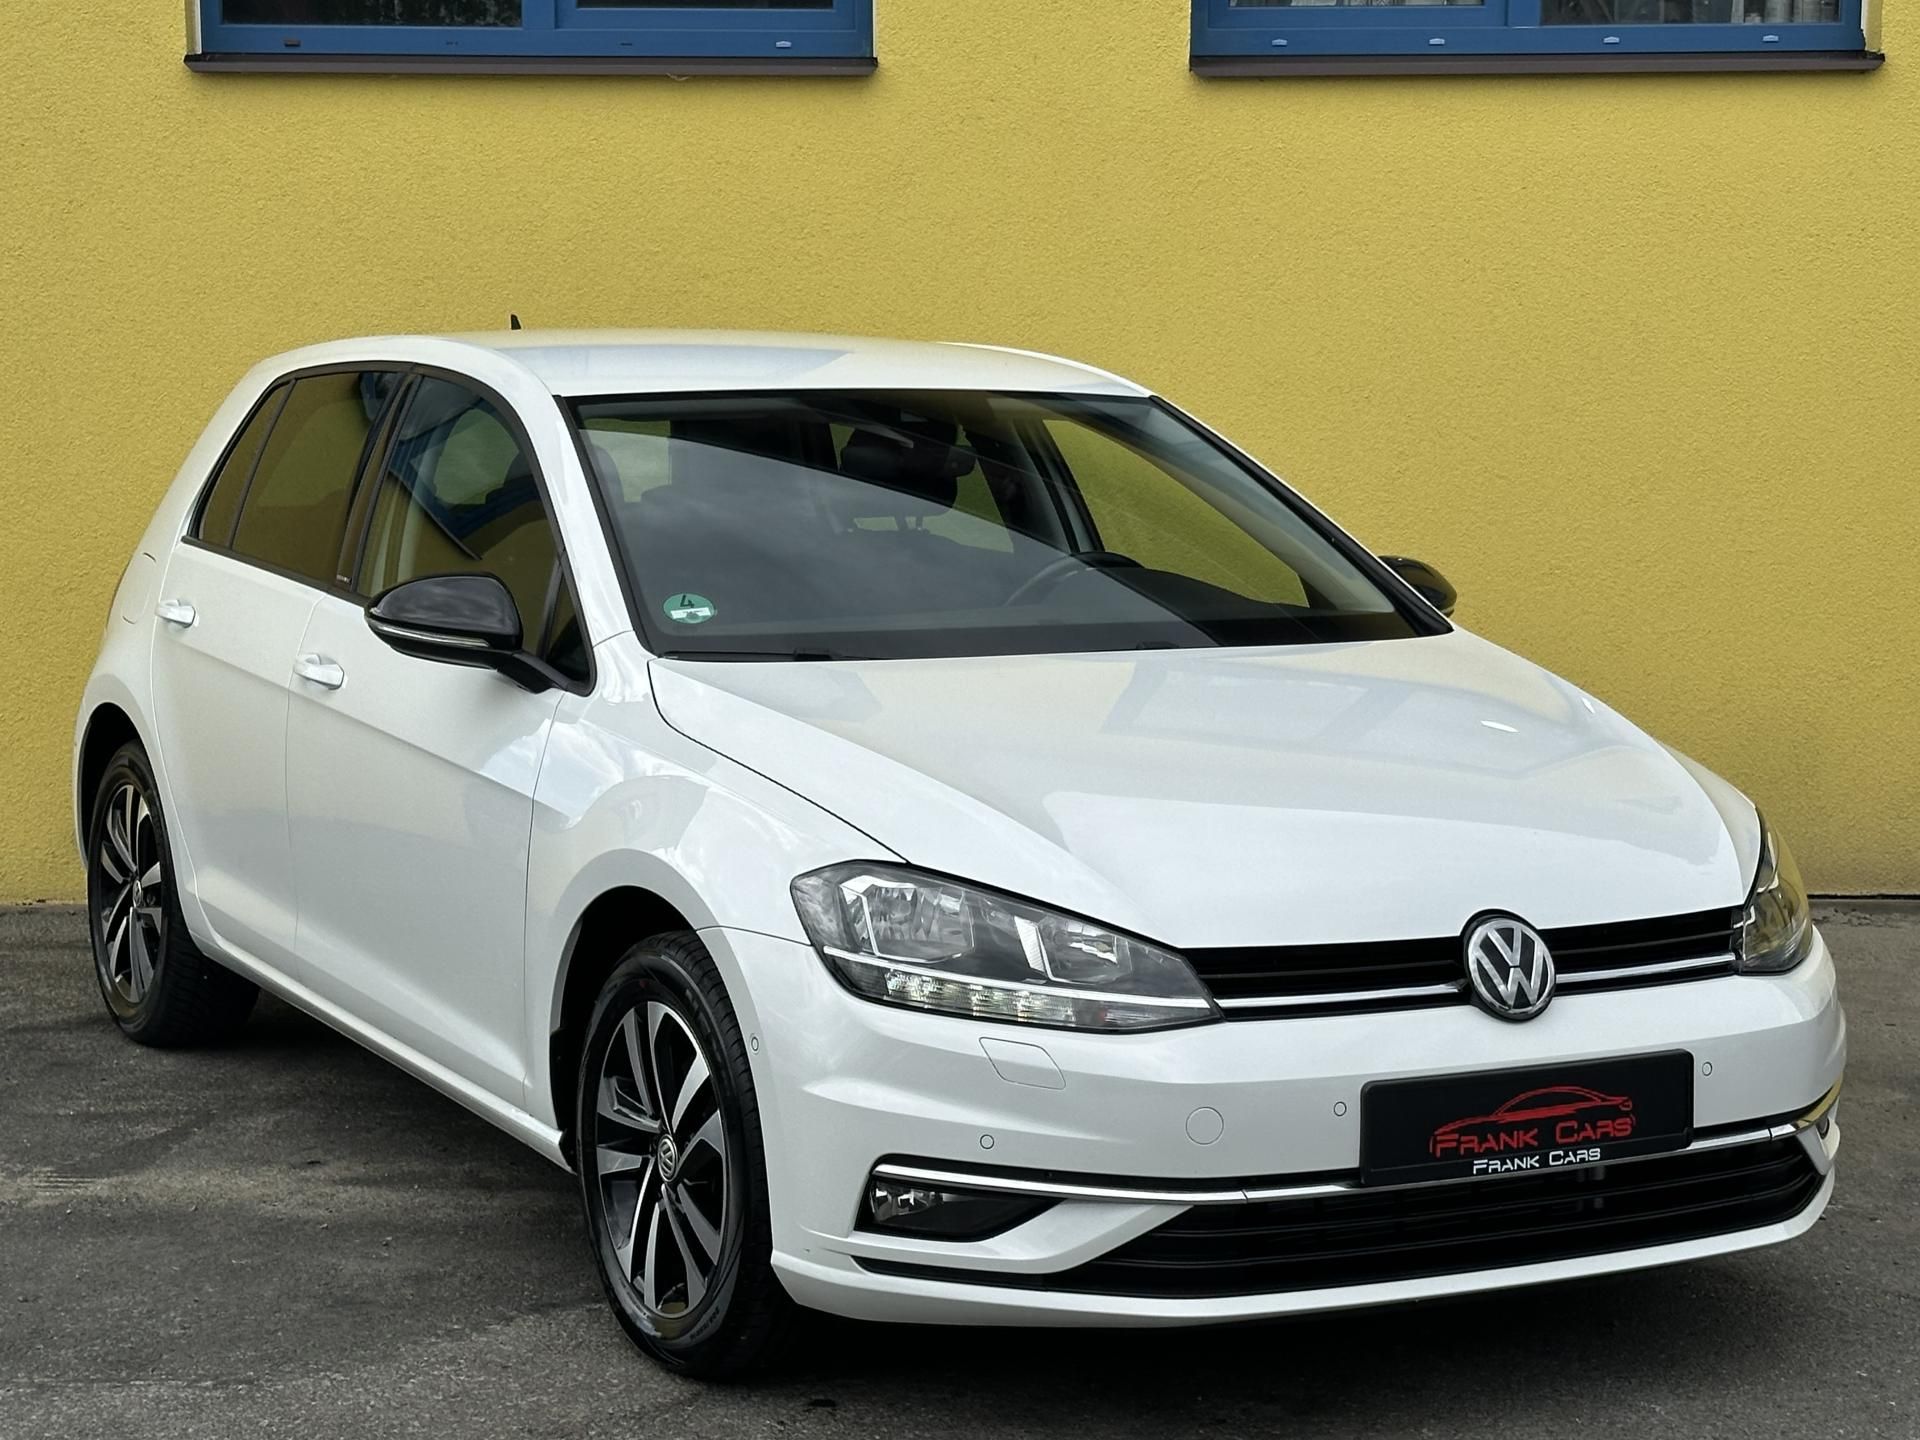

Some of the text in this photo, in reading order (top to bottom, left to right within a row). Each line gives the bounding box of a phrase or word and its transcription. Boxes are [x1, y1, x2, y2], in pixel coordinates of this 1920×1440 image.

[680, 594, 695, 608] 4
[1468, 917, 1555, 1014] VW
[1434, 1117, 1633, 1158] FRANK CARS
[1473, 1147, 1601, 1175] FRANK CARS
